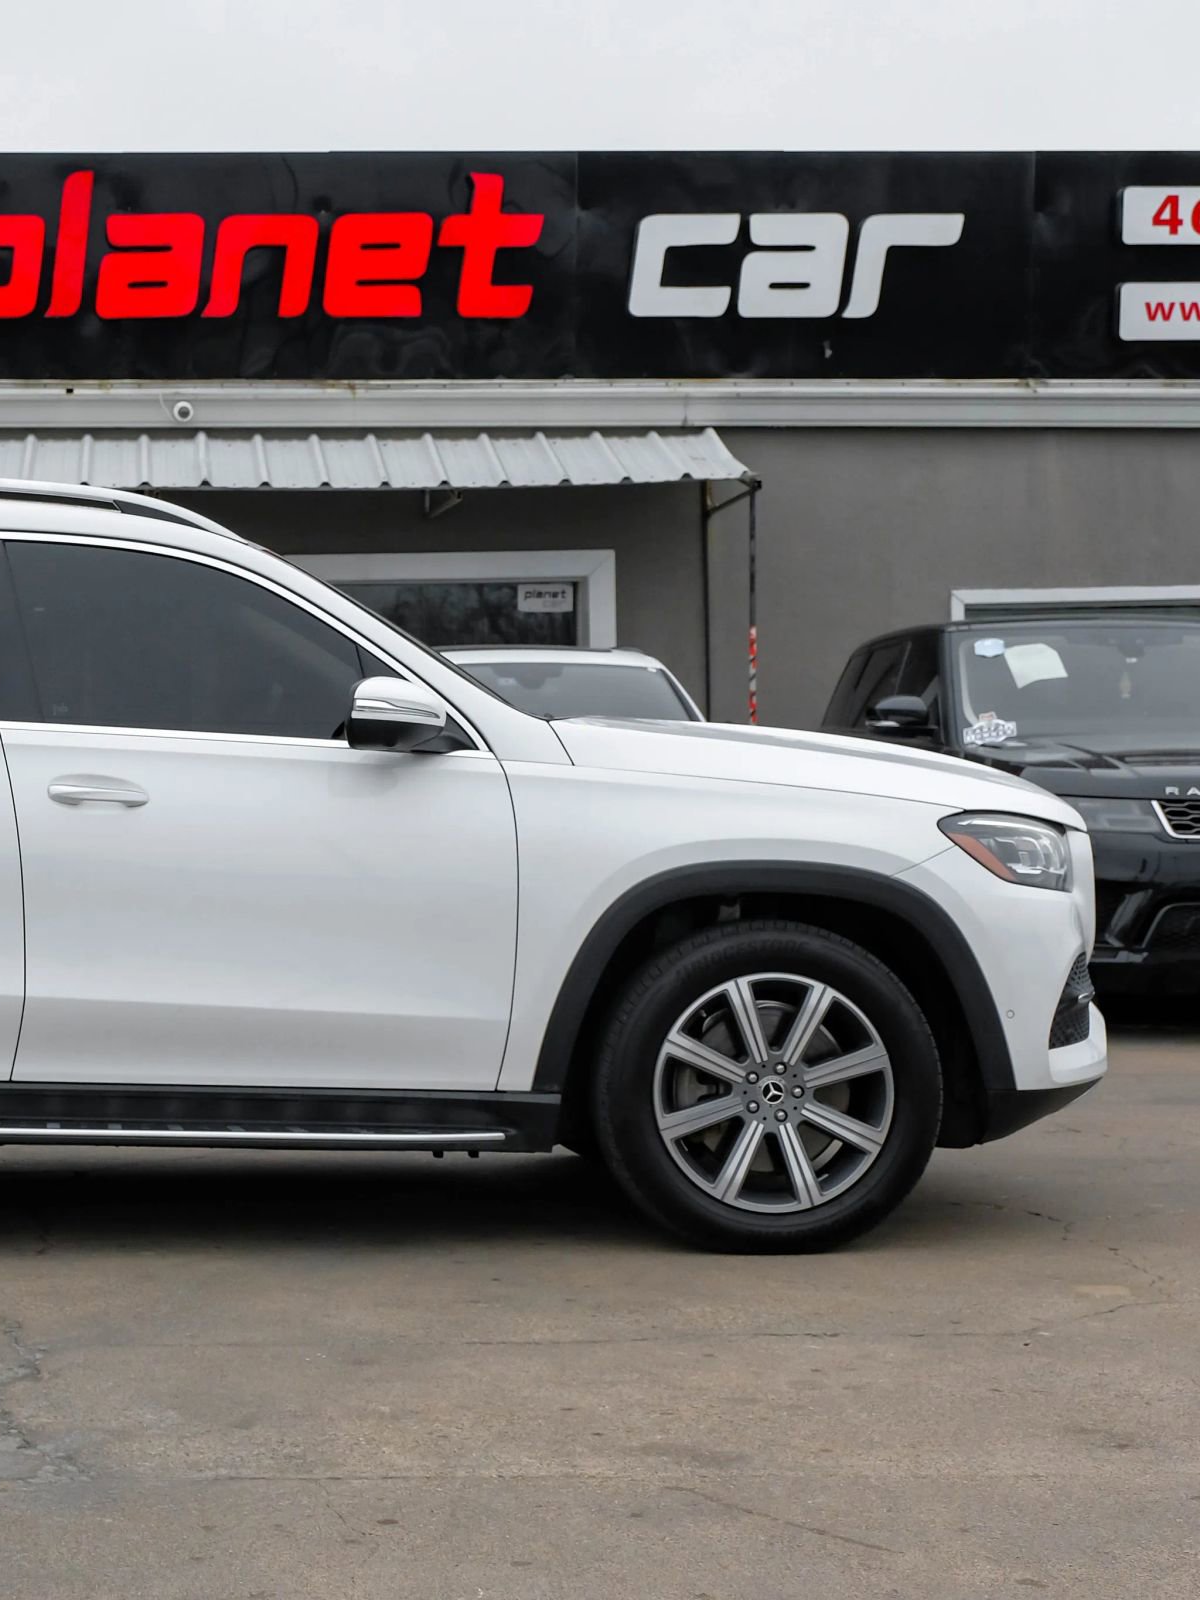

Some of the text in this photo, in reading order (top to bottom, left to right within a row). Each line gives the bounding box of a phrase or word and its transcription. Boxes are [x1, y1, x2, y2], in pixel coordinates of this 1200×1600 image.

[628, 212, 965, 319] car
[524, 588, 567, 601] planet
[1165, 786, 1200, 796] RA
